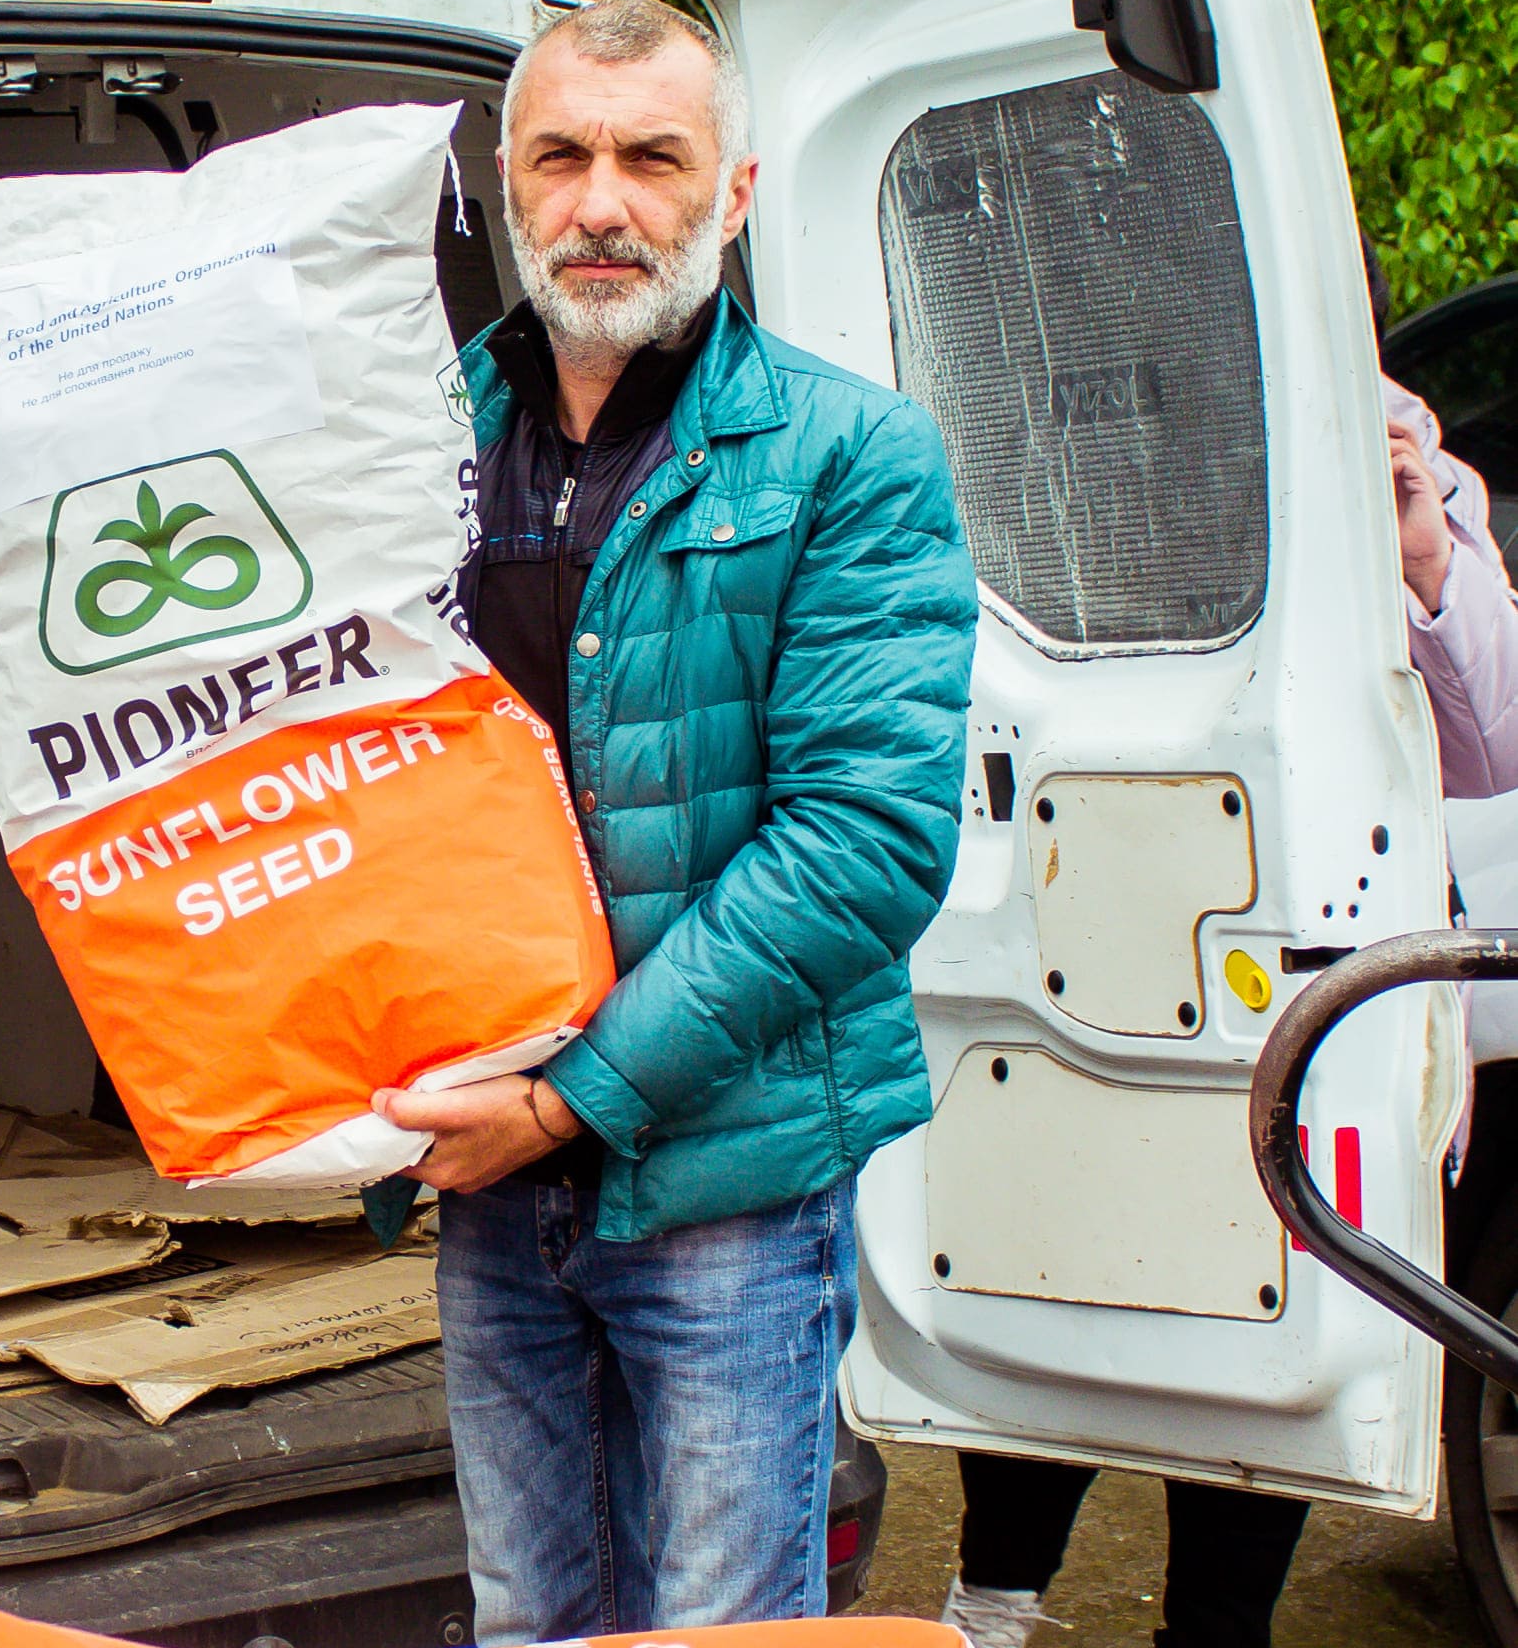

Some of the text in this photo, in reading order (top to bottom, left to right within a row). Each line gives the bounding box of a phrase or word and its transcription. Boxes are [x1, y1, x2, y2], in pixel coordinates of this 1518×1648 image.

[6, 241, 277, 341] Food and Agriculture Organization
[8, 295, 175, 362] of the United Nations
[21, 398, 38, 409] Не
[58, 345, 153, 384] Не для продажу
[27, 613, 380, 801] PIONEER
[48, 720, 447, 912] SUNFLOWER
[547, 748, 603, 918] SUNFLOWER
[176, 828, 354, 937] SEED
